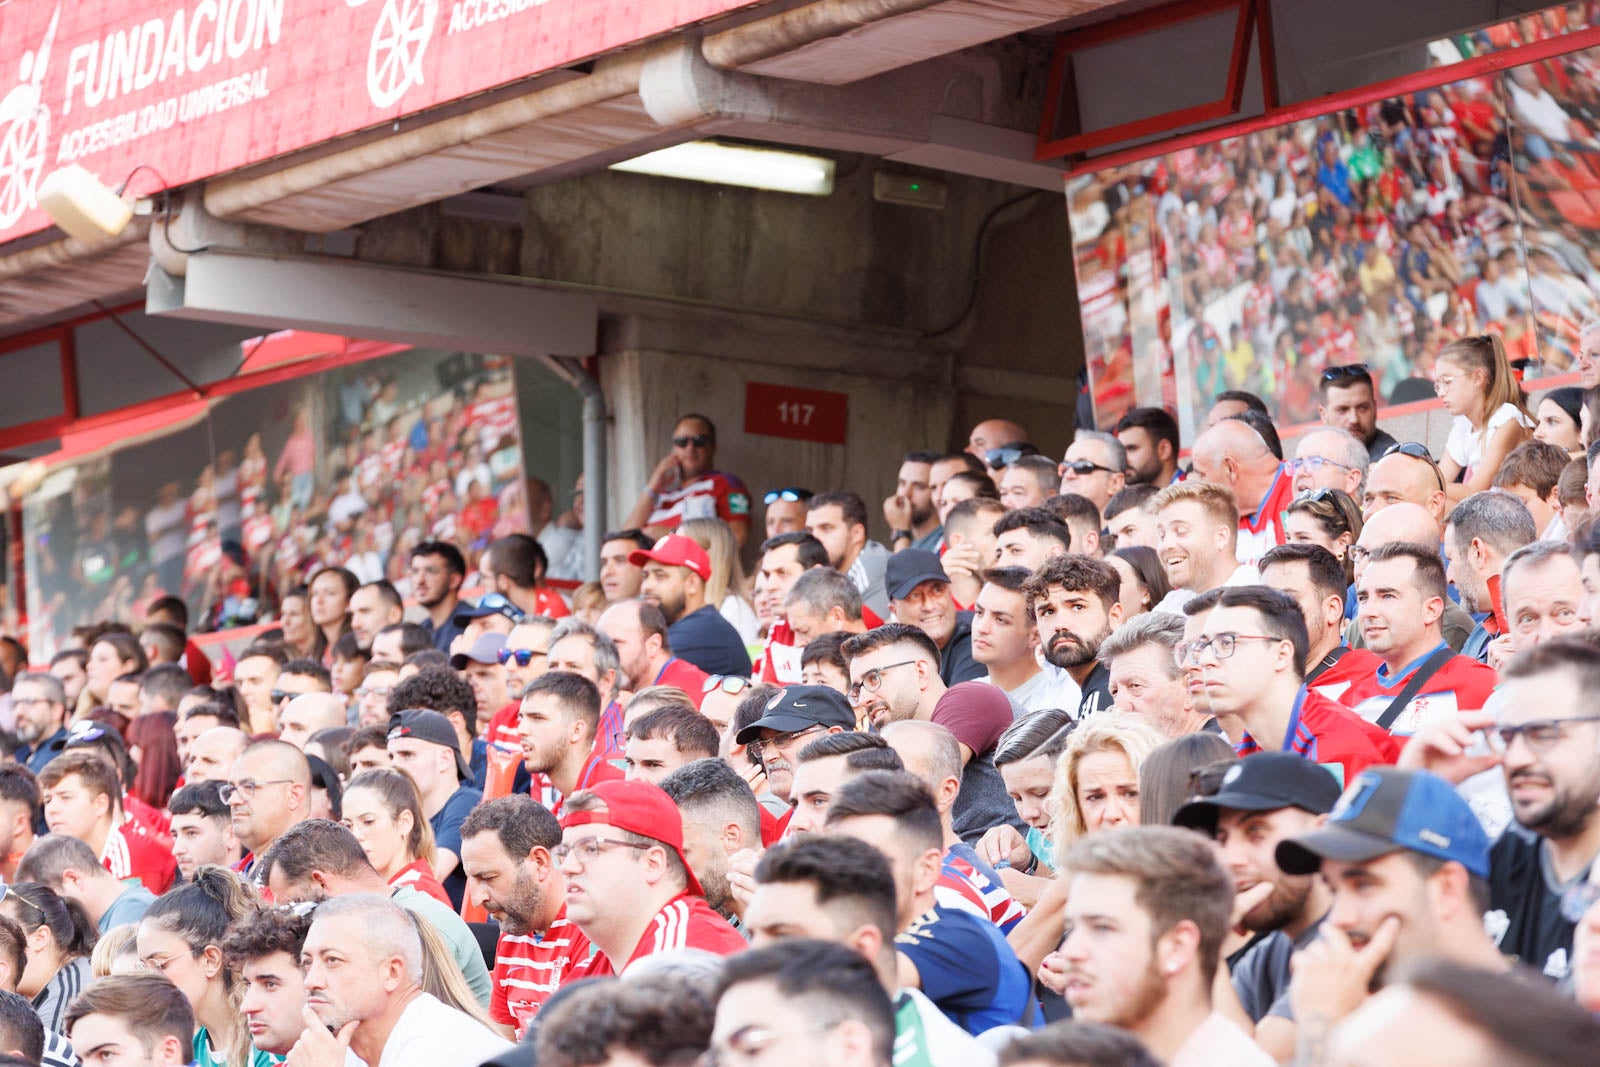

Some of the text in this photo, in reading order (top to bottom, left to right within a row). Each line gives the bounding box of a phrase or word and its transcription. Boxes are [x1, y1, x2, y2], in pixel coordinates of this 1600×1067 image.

[56, 67, 270, 164] ACCESIBILIDAD UNIVERSAL
[777, 401, 816, 426] 117
